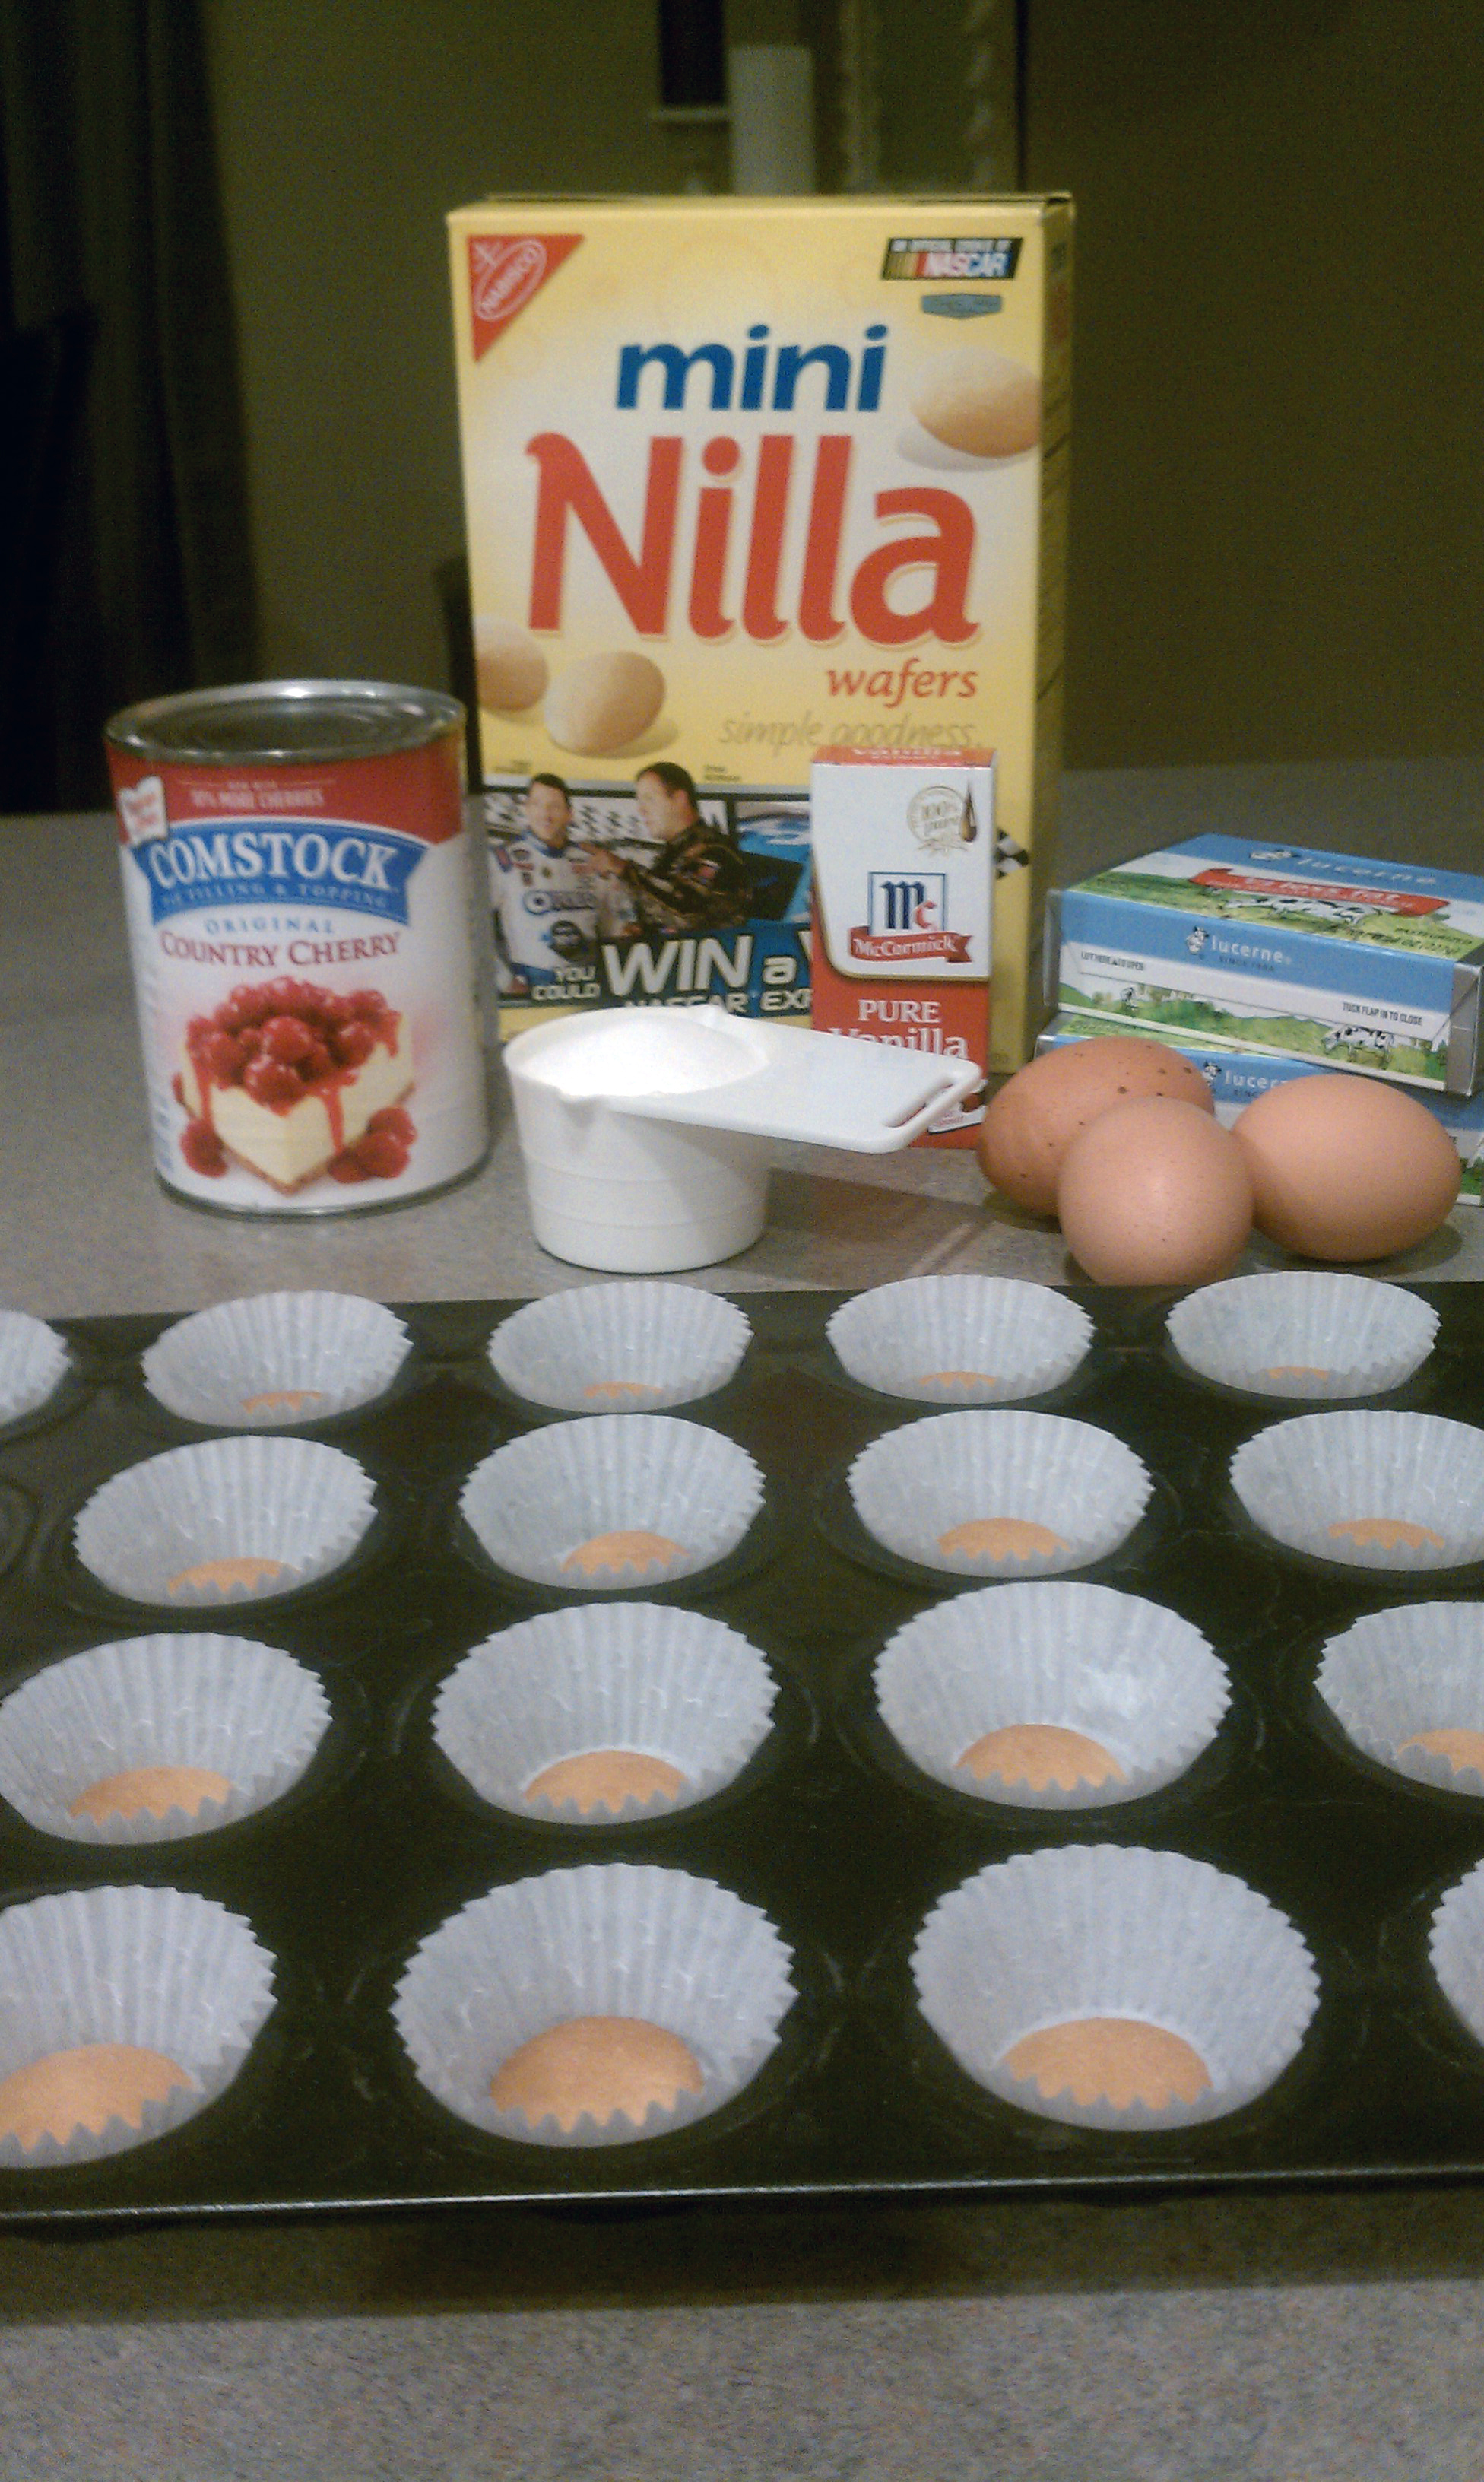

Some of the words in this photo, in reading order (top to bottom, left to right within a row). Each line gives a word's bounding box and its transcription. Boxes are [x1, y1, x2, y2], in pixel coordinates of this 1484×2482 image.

[923, 252, 1009, 278] NASCAR
[615, 323, 888, 411] mini
[525, 432, 980, 646] Nilla
[827, 656, 979, 709] wafers
[721, 709, 826, 758] simple
[149, 832, 398, 890] COMSTOCK
[205, 917, 335, 935] ORIGINAL
[161, 931, 280, 967] COUNTRY
[288, 932, 401, 966] CHERRY
[852, 935, 959, 957] McCormick
[1212, 935, 1283, 963] lucerne
[553, 966, 596, 982] YOU
[601, 934, 753, 997] WIN
[762, 955, 797, 984] a
[531, 982, 601, 1001] COULD
[858, 998, 943, 1024] PURE
[1343, 1002, 1361, 1014] TUCK
[1361, 1005, 1380, 1017] FLAP
[1380, 1010, 1388, 1019] IN
[1389, 1011, 1399, 1021] TO
[1399, 1014, 1423, 1026] CLOSE
